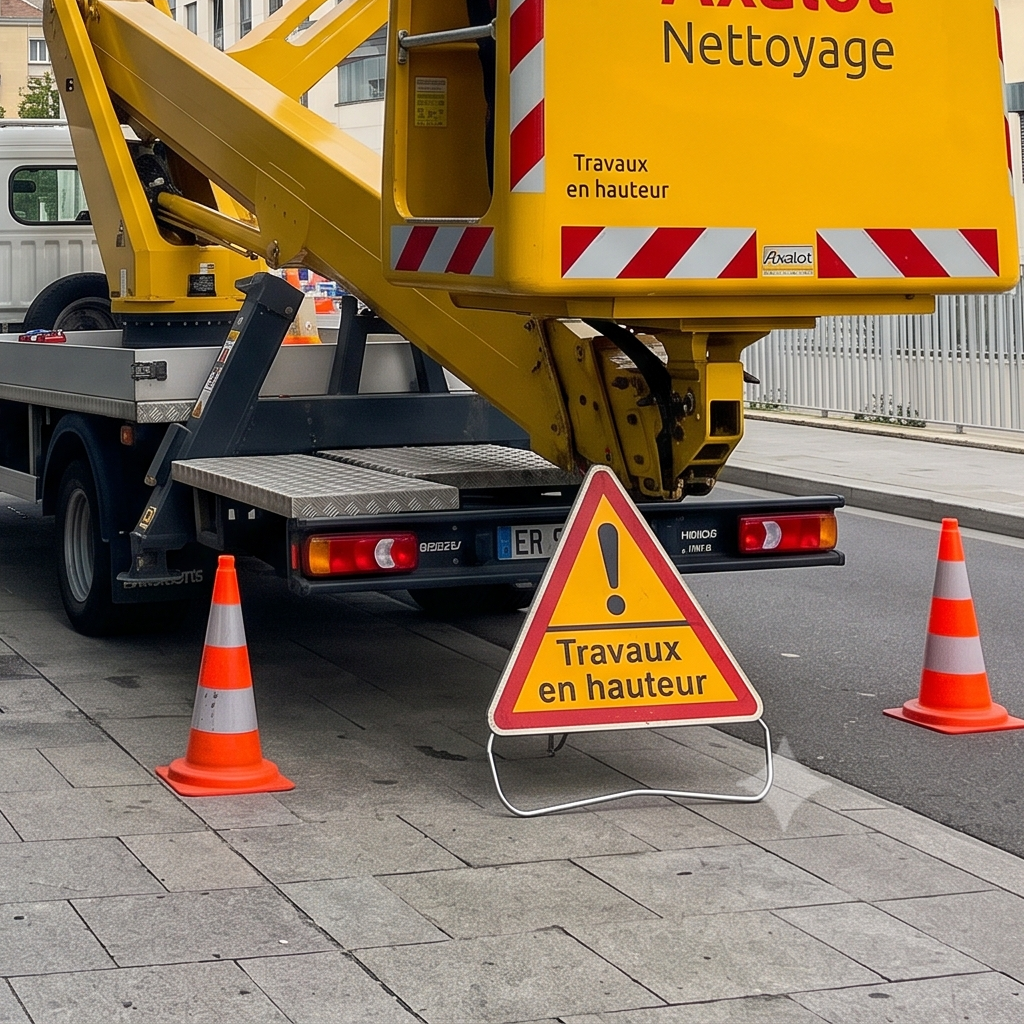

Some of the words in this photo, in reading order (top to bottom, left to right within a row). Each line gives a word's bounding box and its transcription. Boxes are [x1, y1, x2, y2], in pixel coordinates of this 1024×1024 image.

[663, 20, 895, 80] Nettoyage
[573, 154, 648, 172] Travaux
[566, 183, 589, 198] en
[595, 178, 670, 199] hauteur
[763, 250, 813, 265] Axalot
[515, 529, 543, 555] ER
[556, 638, 683, 666] Travaux
[538, 680, 577, 704] en
[586, 672, 708, 701] hauteur
